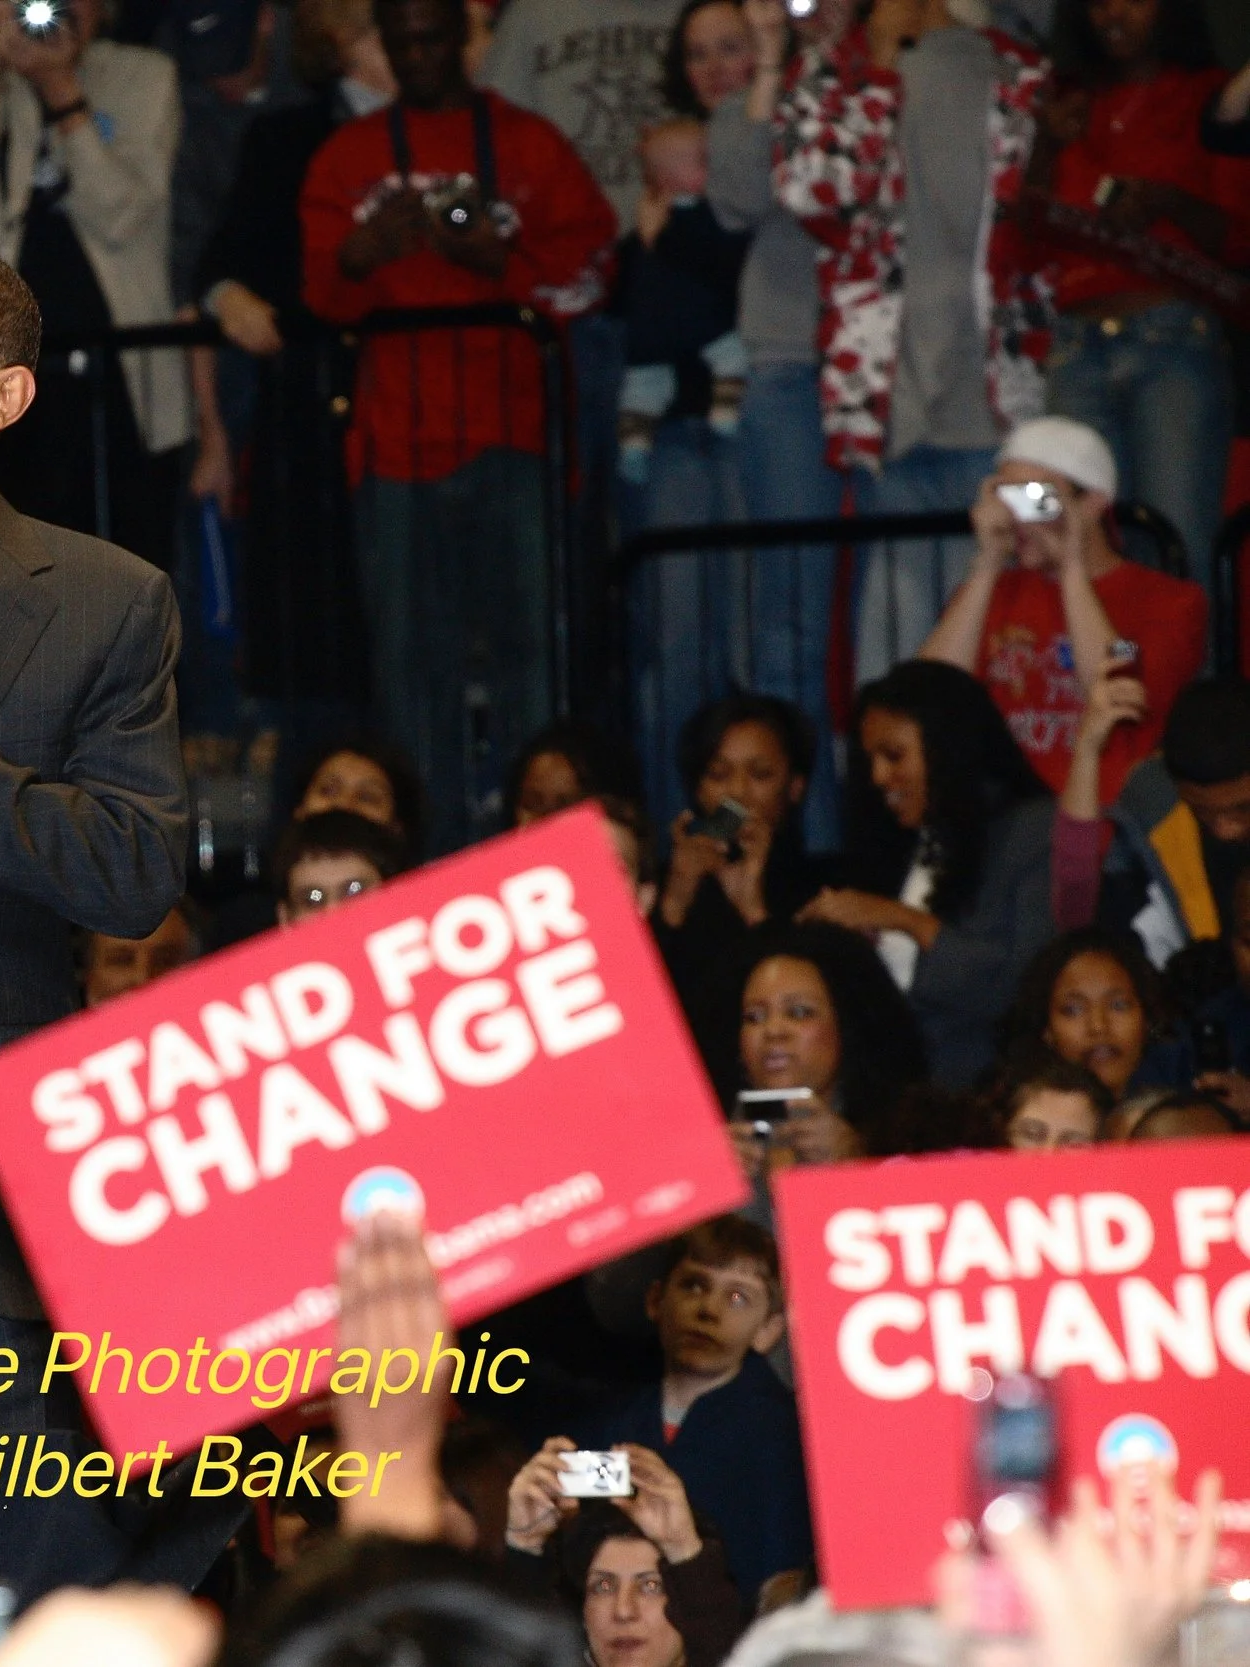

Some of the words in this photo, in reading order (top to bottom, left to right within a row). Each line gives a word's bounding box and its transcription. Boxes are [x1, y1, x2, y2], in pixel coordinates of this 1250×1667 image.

[31, 961, 354, 1153] STAND
[365, 865, 586, 1009] FOR
[68, 938, 624, 1246] CHANGE
[824, 1191, 1155, 1292] STAND
